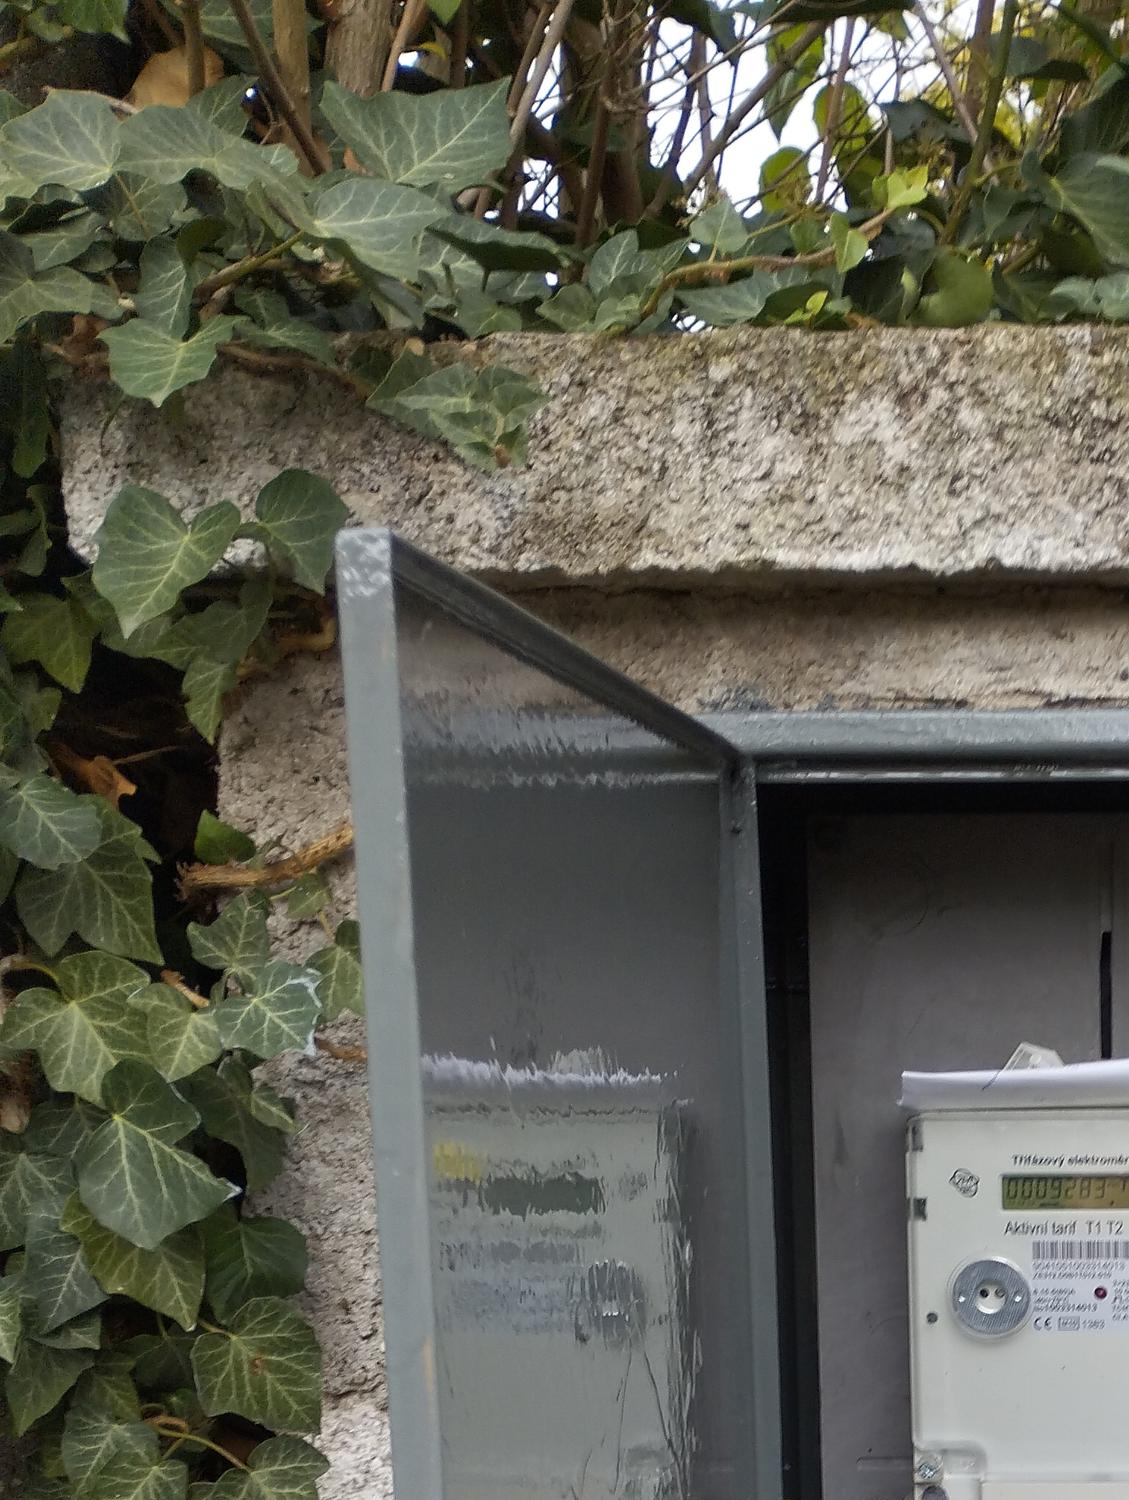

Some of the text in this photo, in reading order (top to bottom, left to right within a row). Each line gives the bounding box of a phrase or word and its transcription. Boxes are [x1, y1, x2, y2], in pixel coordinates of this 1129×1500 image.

[1004, 1220, 1124, 1236] Aktivní tarif T1 T2
